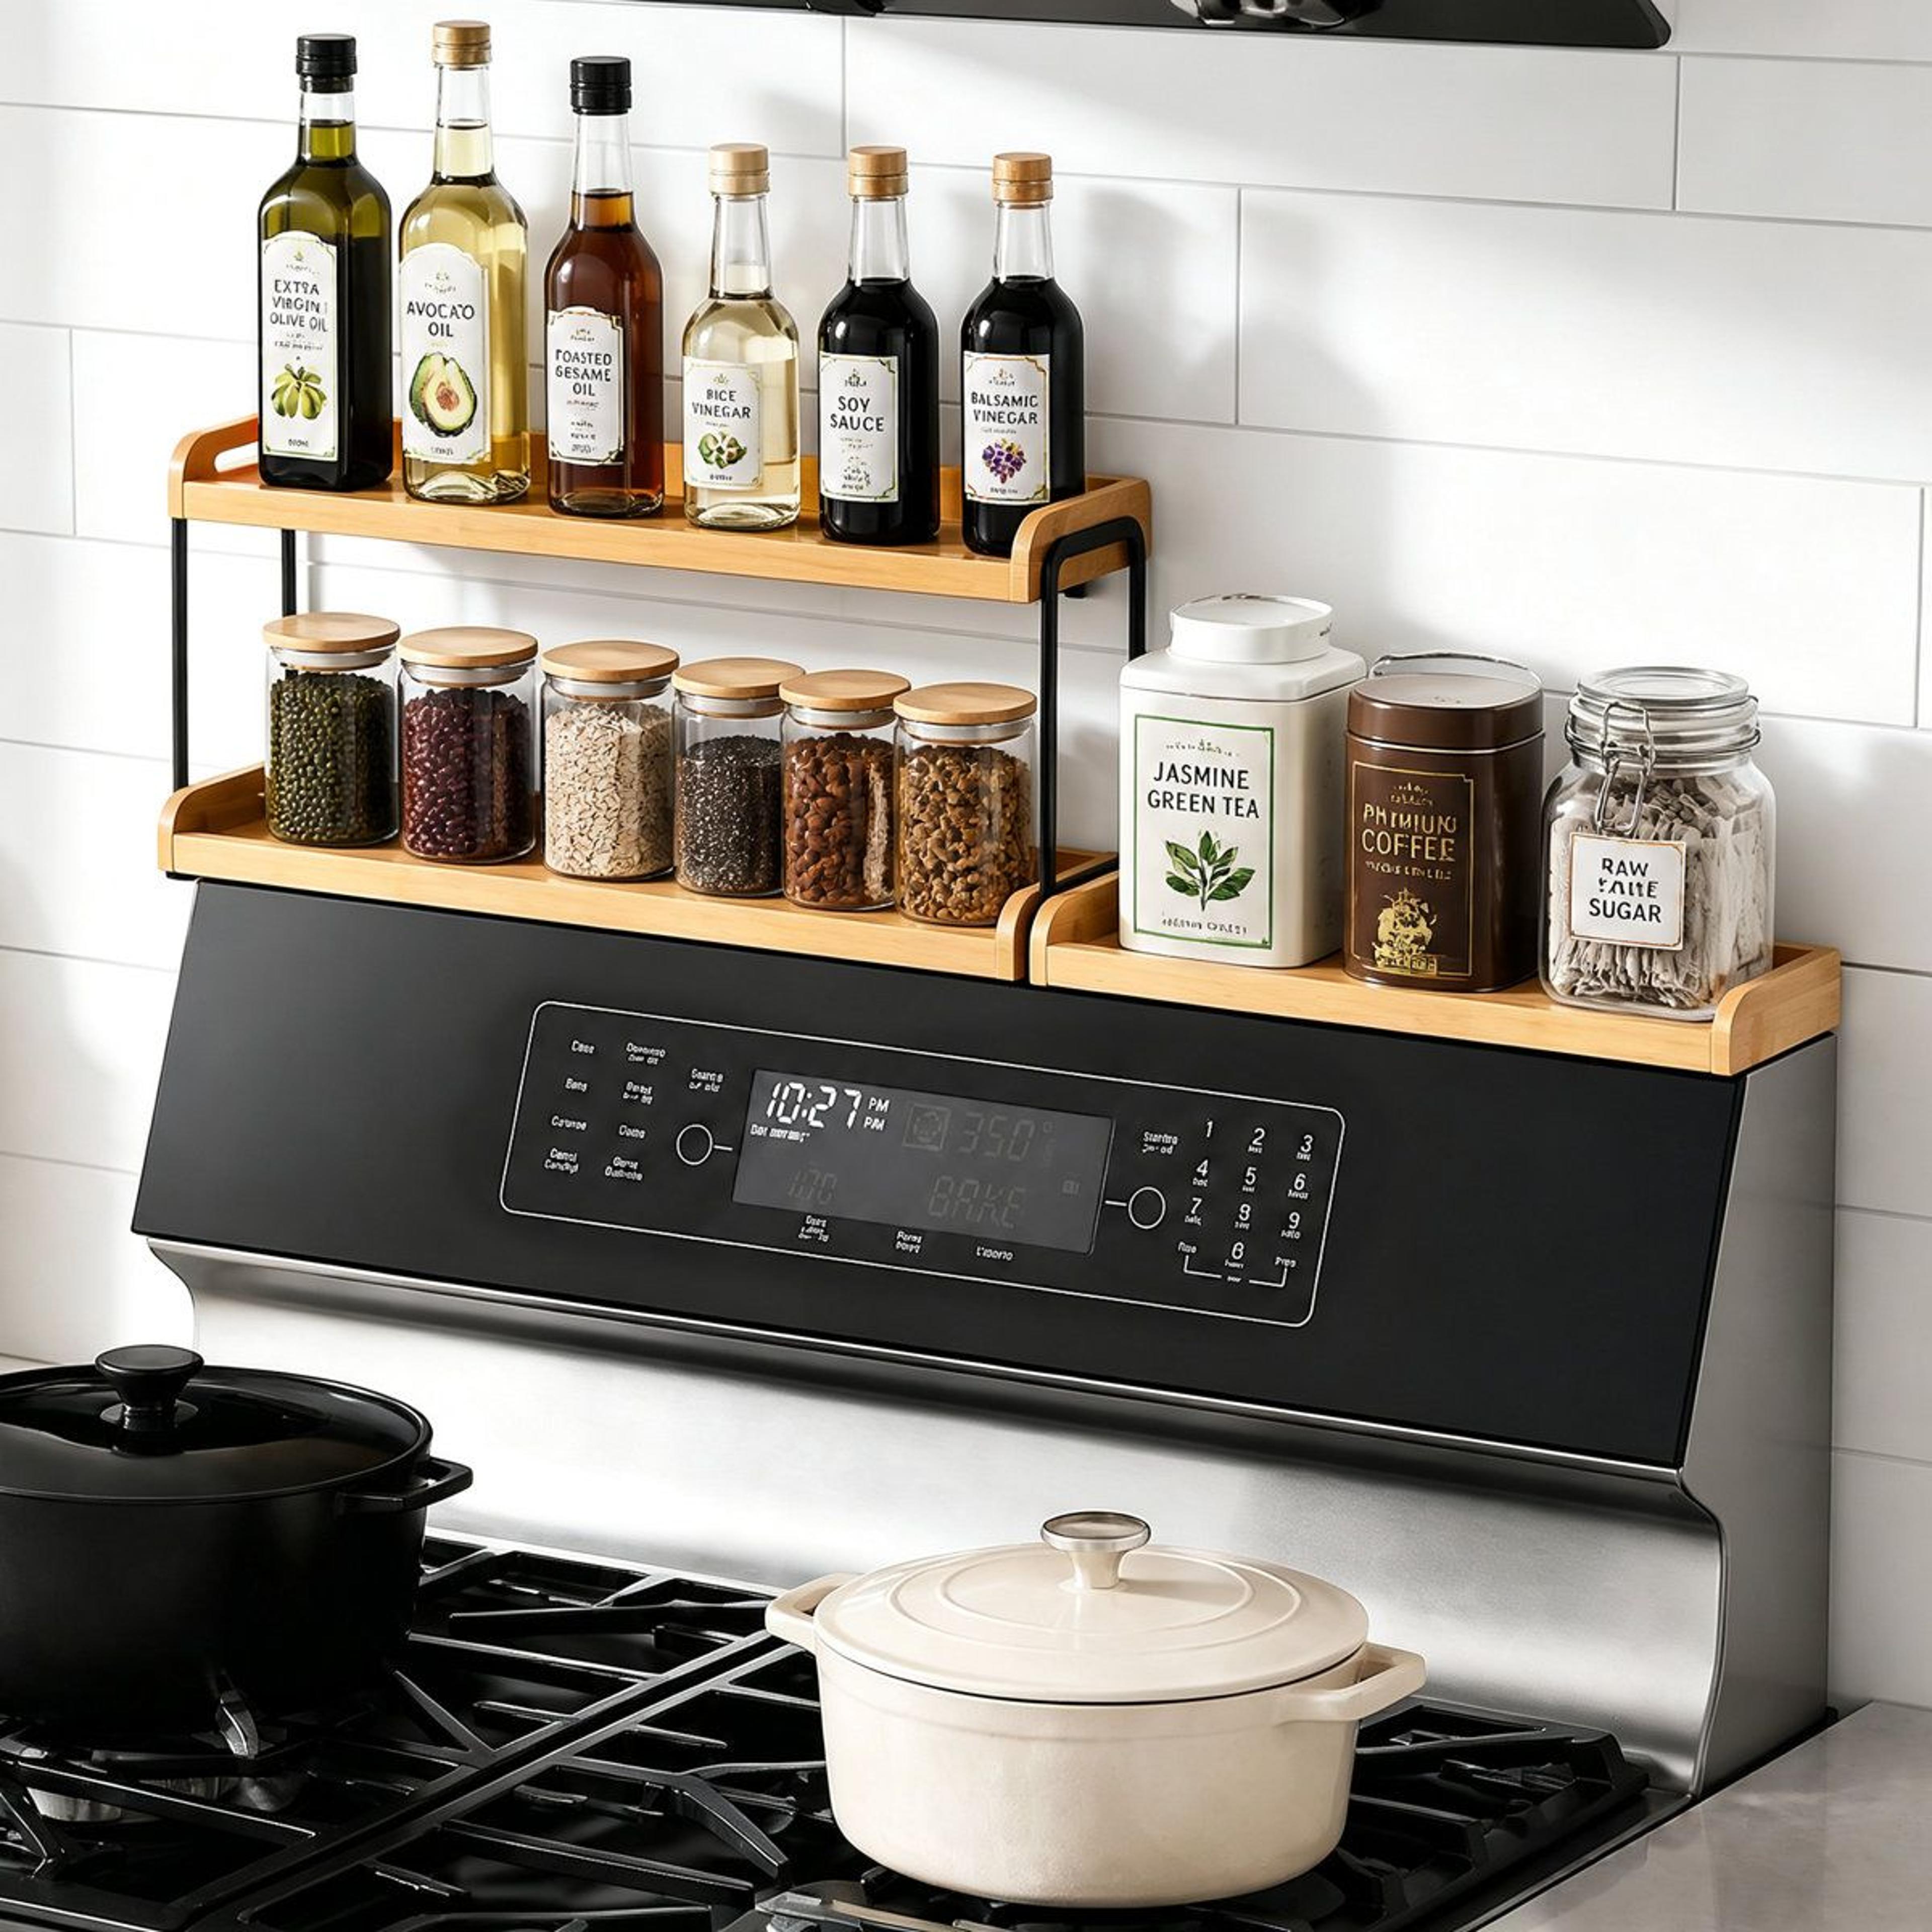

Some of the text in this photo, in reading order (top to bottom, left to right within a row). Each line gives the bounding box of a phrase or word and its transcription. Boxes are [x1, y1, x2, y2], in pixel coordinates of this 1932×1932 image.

[272, 296, 320, 314] VIRGIN
[270, 312, 328, 333] OLIVE OIL
[428, 321, 454, 338] OIL
[572, 382, 596, 396] OIL
[838, 395, 870, 413] SOY
[971, 391, 1039, 408] BALSAMIC
[692, 402, 751, 419] VINEGAR
[973, 410, 1038, 425] VINEGAR
[830, 413, 884, 433] SAUCE
[1153, 761, 1250, 790] JASMINE
[1147, 789, 1260, 819] GREEN TEA
[1361, 828, 1456, 862] COFFEE
[1601, 857, 1649, 877] RAW
[1588, 898, 1661, 923] SUGAR
[766, 1082, 890, 1129] 10:27 PM
[863, 1116, 886, 1131] PM
[1206, 1120, 1213, 1138] 1
[1252, 1127, 1265, 1146] 2
[1300, 1135, 1314, 1153] 3
[1196, 1159, 1209, 1177] 4
[1245, 1166, 1257, 1185] 5
[1294, 1173, 1307, 1191] 6
[1190, 1197, 1202, 1215] 7
[1289, 1212, 1301, 1230] 9
